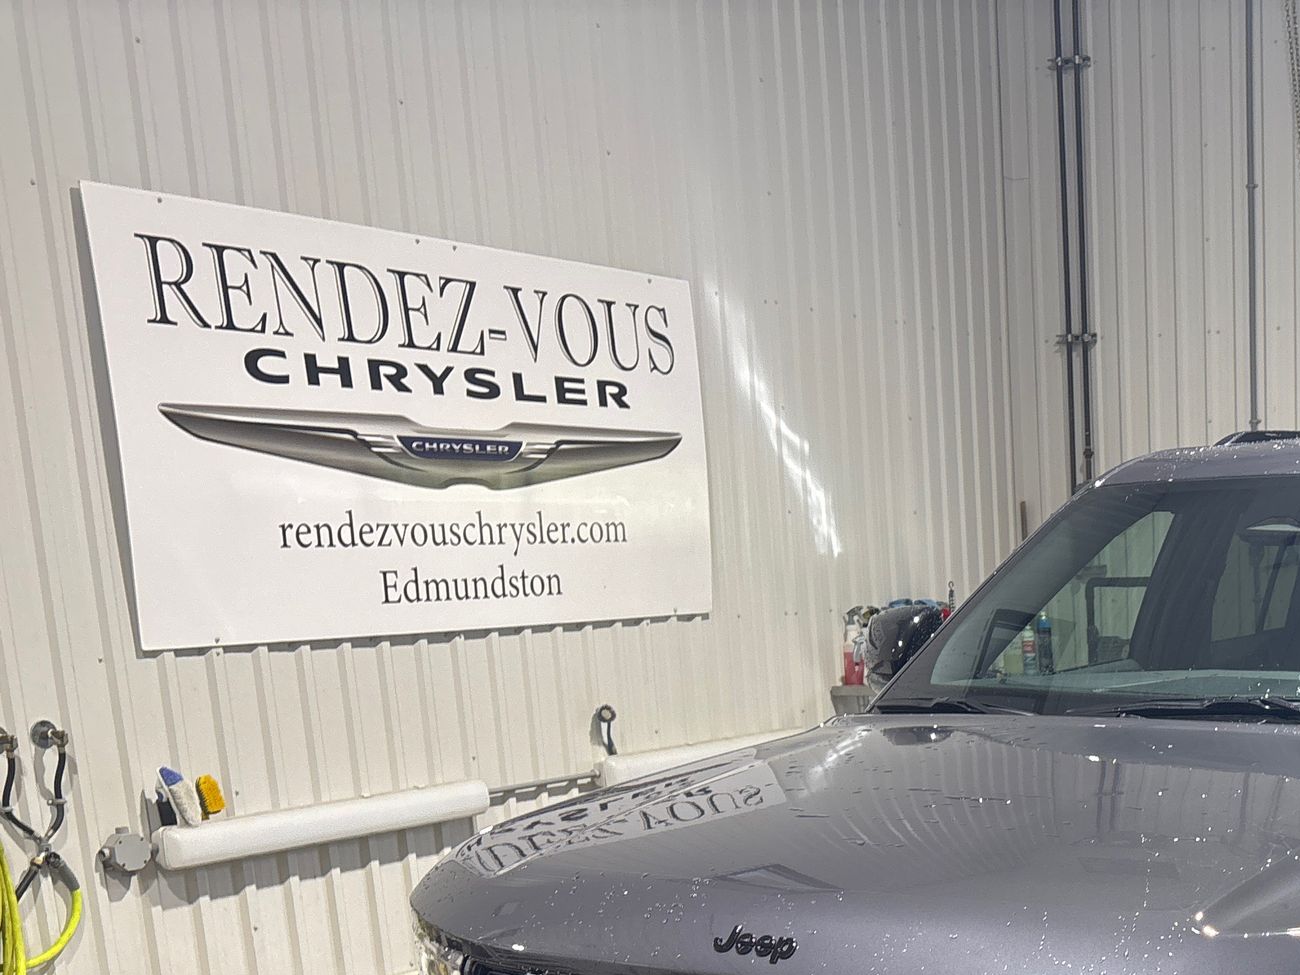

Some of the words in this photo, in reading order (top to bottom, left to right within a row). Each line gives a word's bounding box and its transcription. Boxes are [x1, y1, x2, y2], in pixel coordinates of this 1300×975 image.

[134, 233, 675, 375] RENDEZ-VOUS
[244, 348, 630, 408] CHRYSLER
[411, 441, 509, 455] CHRYSLER
[279, 510, 628, 556] rendezvouschrysler.com
[379, 564, 563, 604] Edmundston
[713, 924, 798, 964] Jeep
